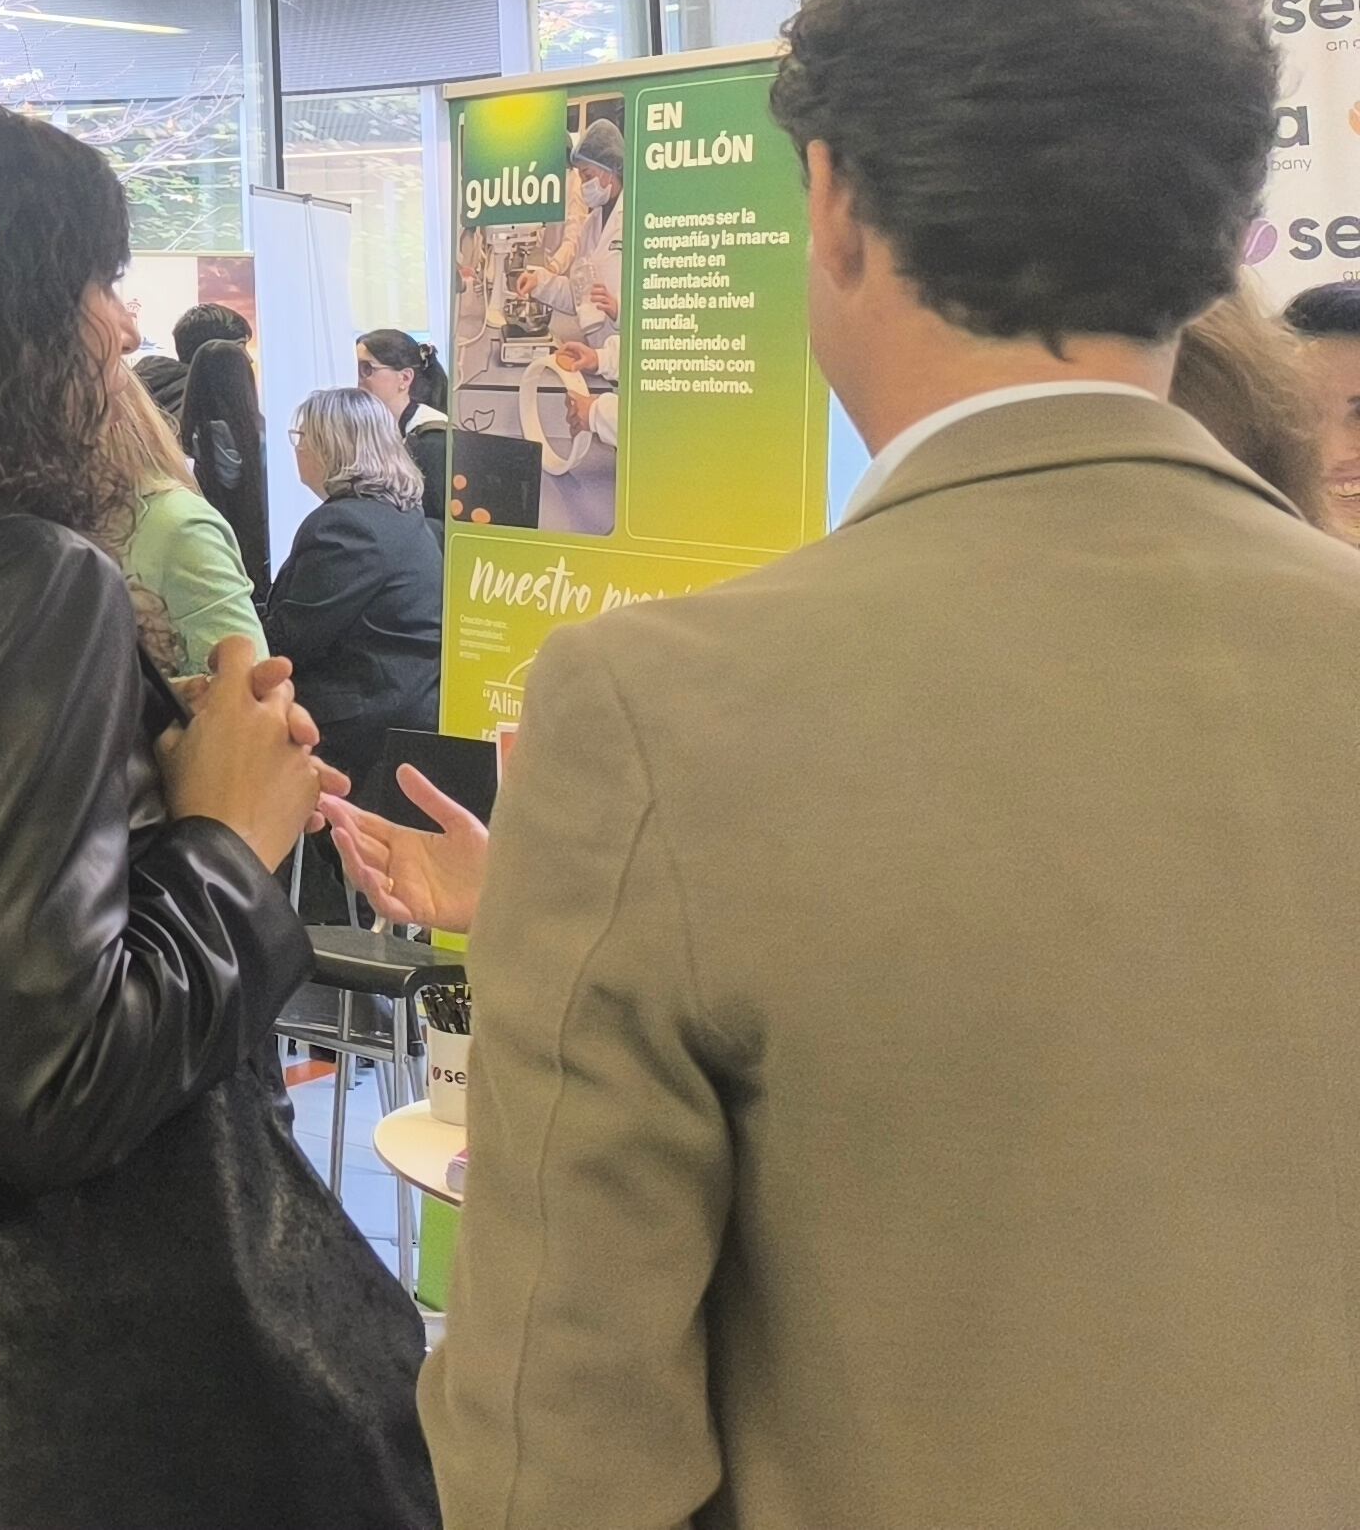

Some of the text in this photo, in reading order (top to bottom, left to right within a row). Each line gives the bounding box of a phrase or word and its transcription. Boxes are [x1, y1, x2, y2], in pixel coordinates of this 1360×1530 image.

[646, 101, 683, 131] EN
[645, 130, 753, 171] GULLÓN
[465, 161, 560, 219] gullón
[644, 207, 756, 229] Queremos ser la
[643, 230, 790, 251] compañía y la marca
[643, 252, 726, 269] referente en
[642, 271, 730, 289] alimentación
[642, 291, 755, 309] saludable a nivel
[641, 313, 698, 333] mundial,
[641, 334, 746, 351] manteniendo el
[640, 355, 756, 374] compromiso con
[640, 376, 753, 394] nuestro entorno.
